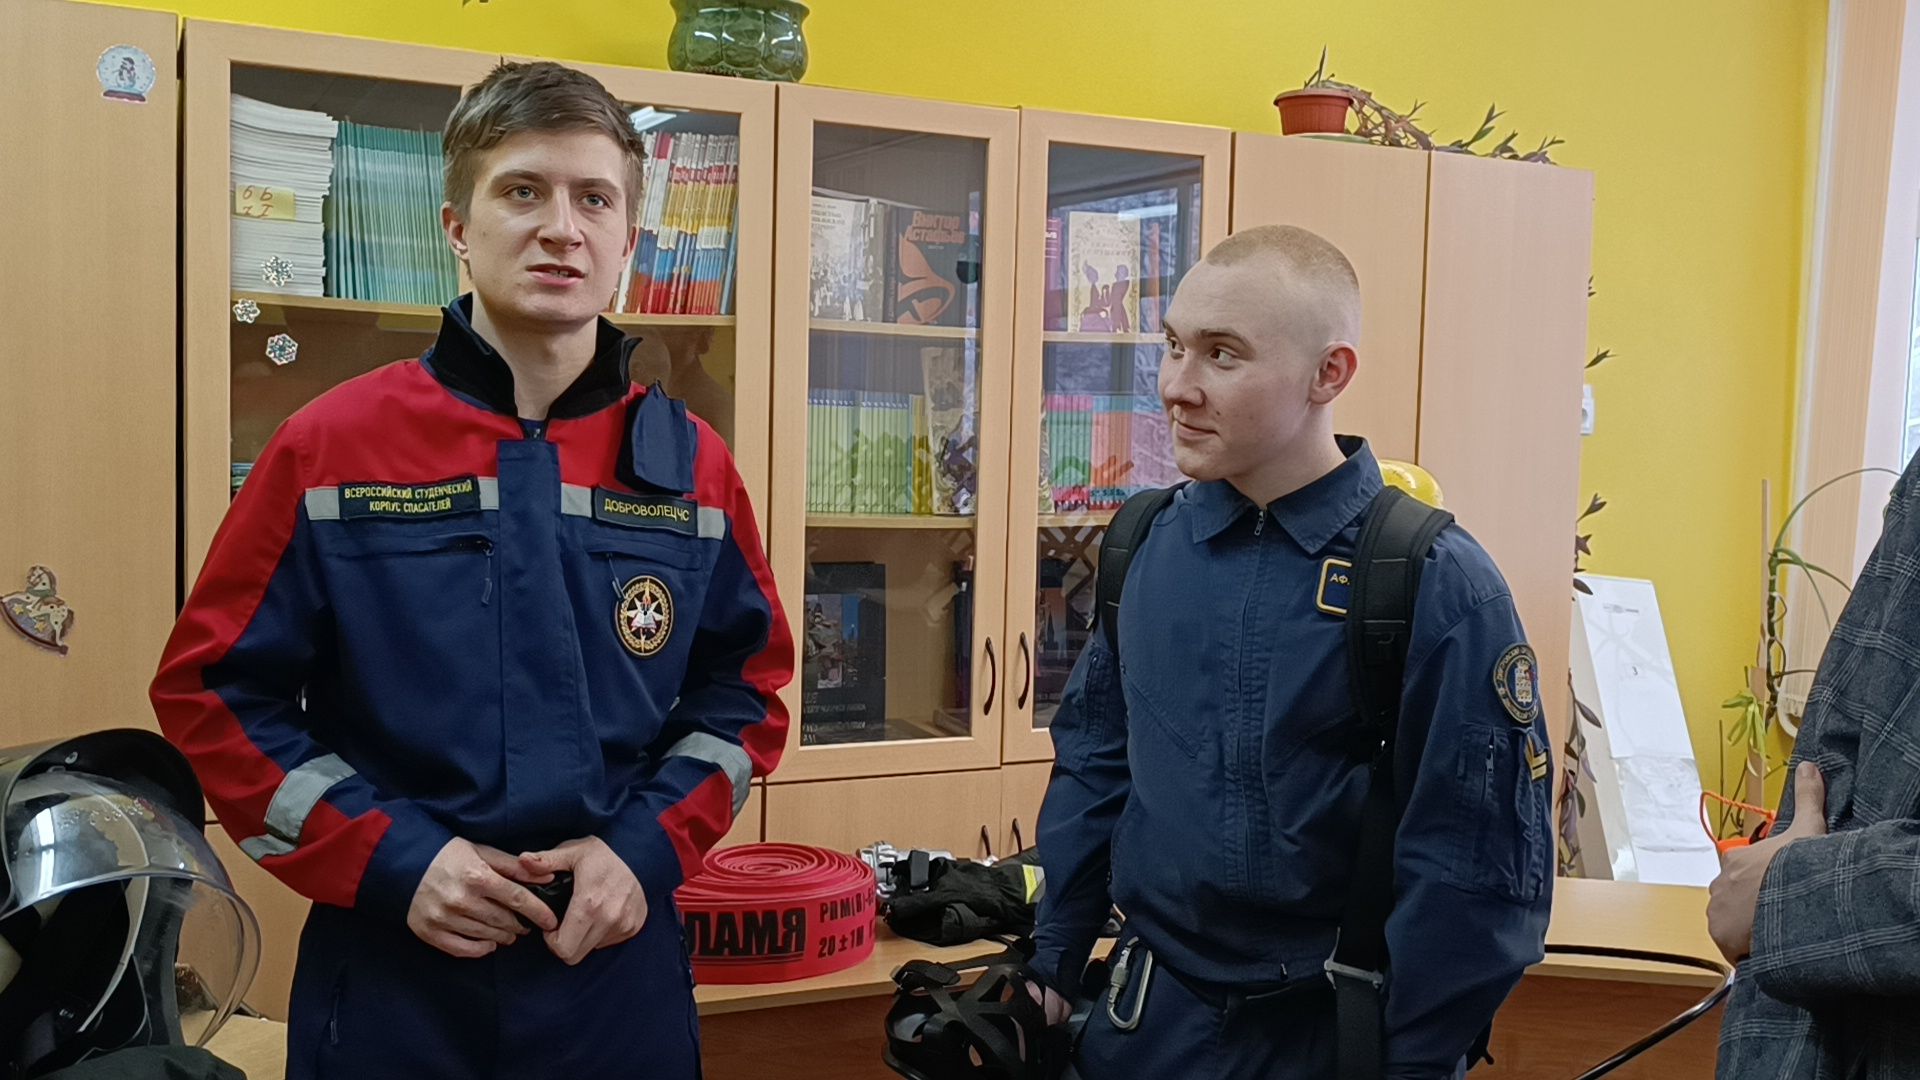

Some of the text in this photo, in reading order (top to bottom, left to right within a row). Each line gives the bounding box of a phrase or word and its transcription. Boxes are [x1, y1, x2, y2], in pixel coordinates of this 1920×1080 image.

[344, 480, 473, 499] ВСЕРОССИЙСКИЙ СТУДЕНЧЕСКИЙ
[369, 498, 452, 513] КОРПУС СПАСАТЕЛЕЙ
[1329, 572, 1351, 586] АФ
[684, 907, 807, 957] ЛАМЯ
